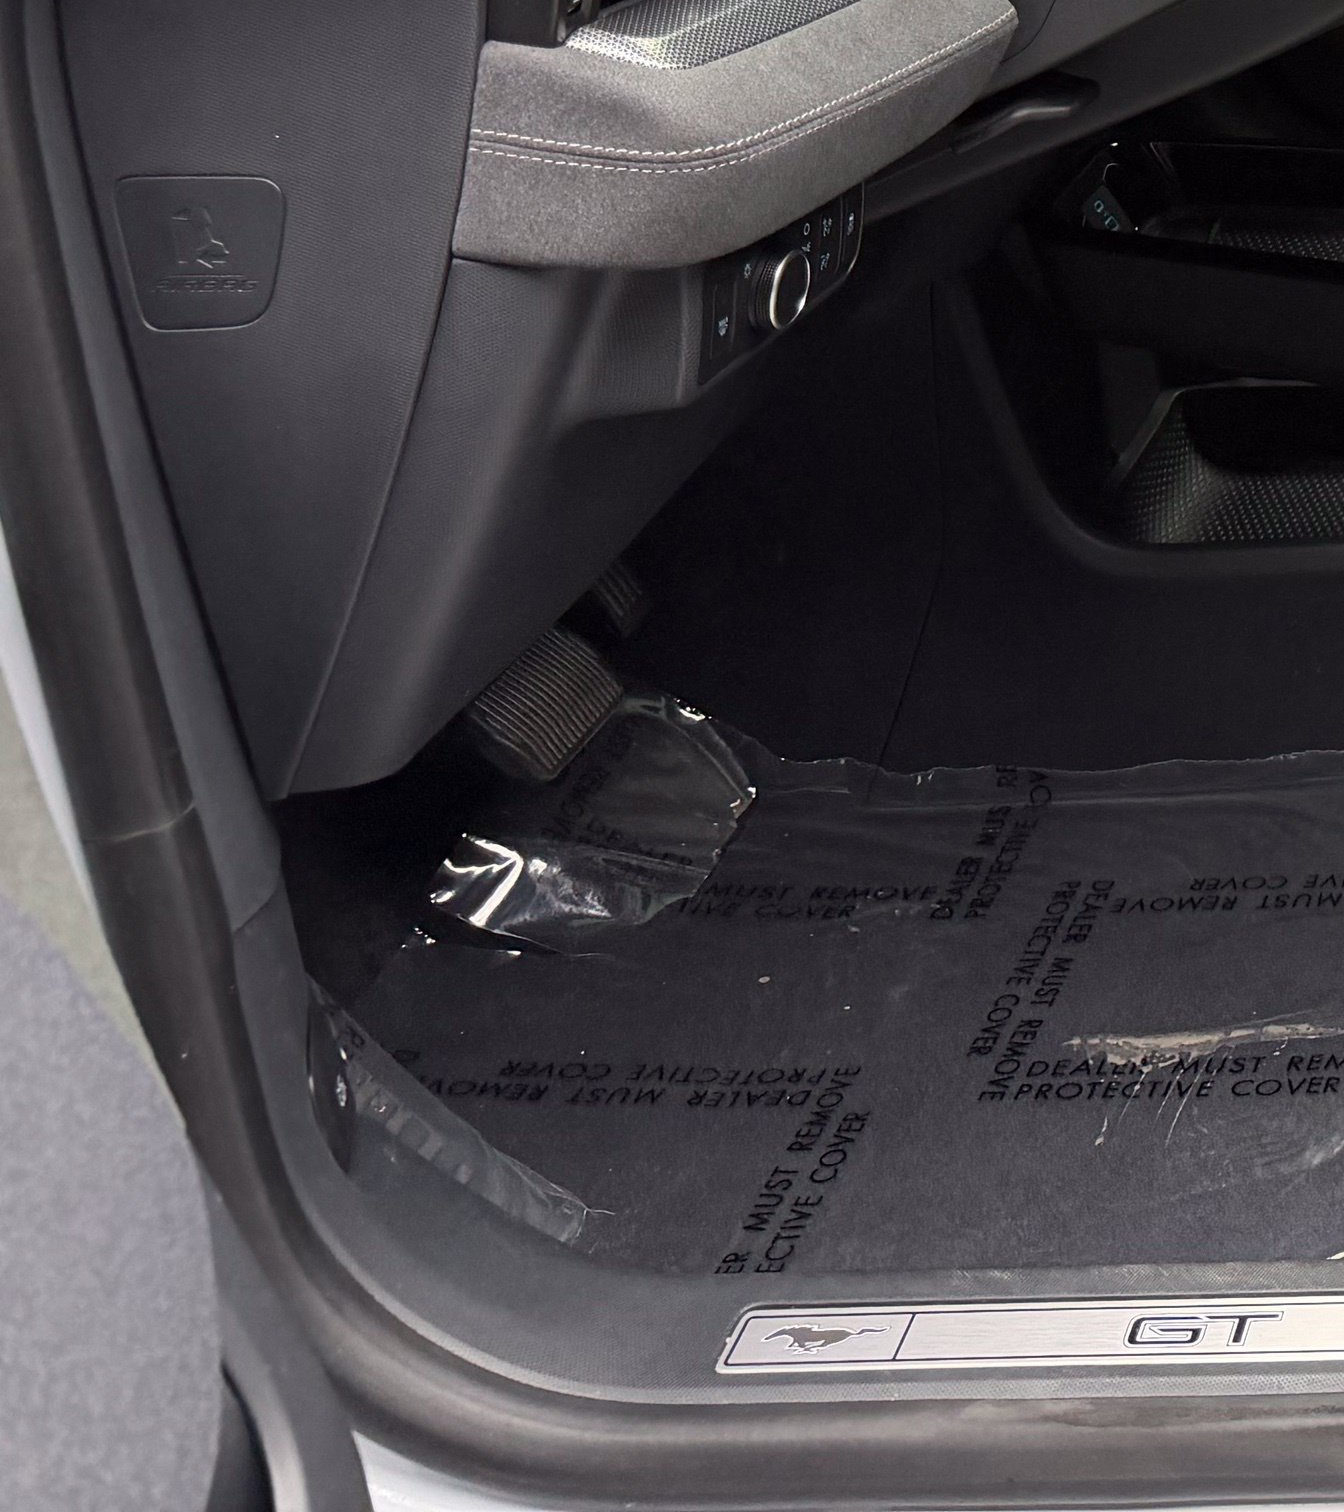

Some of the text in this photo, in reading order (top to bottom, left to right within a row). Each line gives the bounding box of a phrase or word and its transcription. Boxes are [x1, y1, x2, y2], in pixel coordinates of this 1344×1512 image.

[1188, 874, 1288, 890] COVER
[1113, 894, 1237, 913] REMOVE
[1256, 891, 1343, 909] MUST
[1031, 957, 1074, 1007] MUST
[967, 994, 1020, 1058] COVER
[499, 1059, 824, 1086] PROTECTIVE COVER
[978, 1019, 1043, 1101] REMOVE
[1171, 1055, 1267, 1075] MUST
[421, 1073, 810, 1107] DEALER MUST REMOV
[1014, 1076, 1341, 1101] PROTECTIVE COVER
[744, 1166, 799, 1232] MUST
[786, 1066, 861, 1152] REMOVE
[809, 1109, 871, 1183] COVER
[1122, 1309, 1285, 1350] GT
